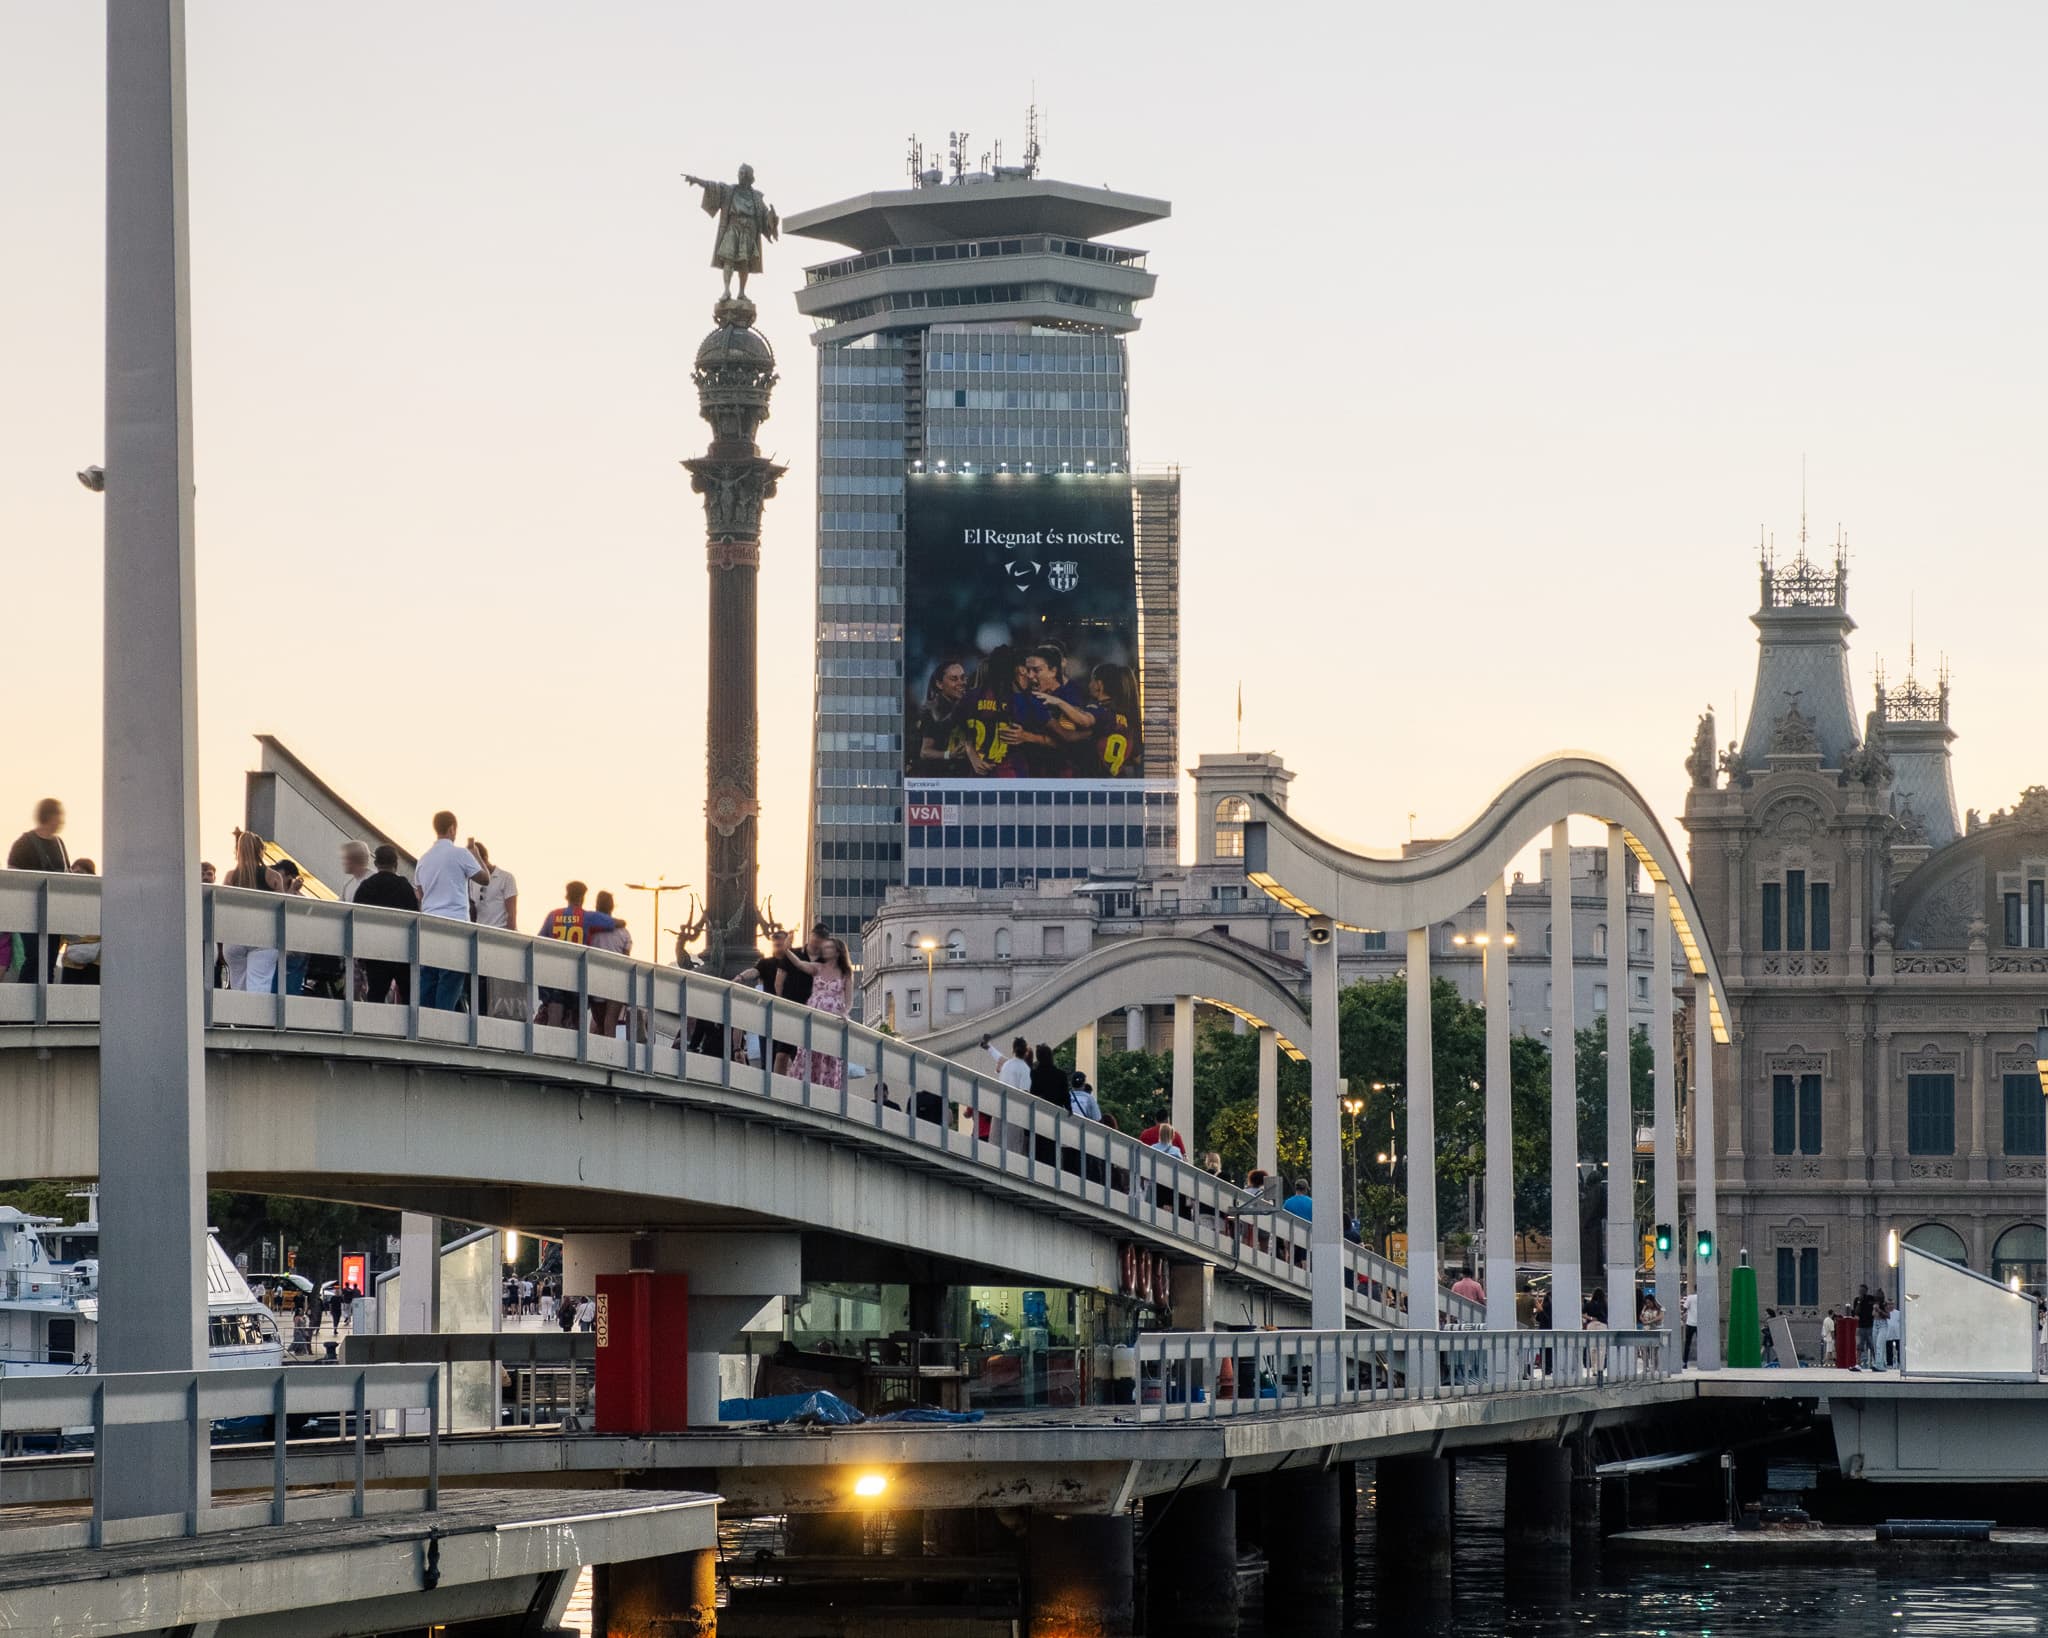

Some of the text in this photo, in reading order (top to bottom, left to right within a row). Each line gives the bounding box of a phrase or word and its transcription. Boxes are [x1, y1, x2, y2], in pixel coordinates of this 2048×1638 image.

[964, 528, 1124, 549] El Regnat és nostre.
[1104, 734, 1127, 776] 9
[911, 807, 940, 820] VSA
[554, 915, 580, 924] MESSI
[598, 1296, 607, 1347] 30254
